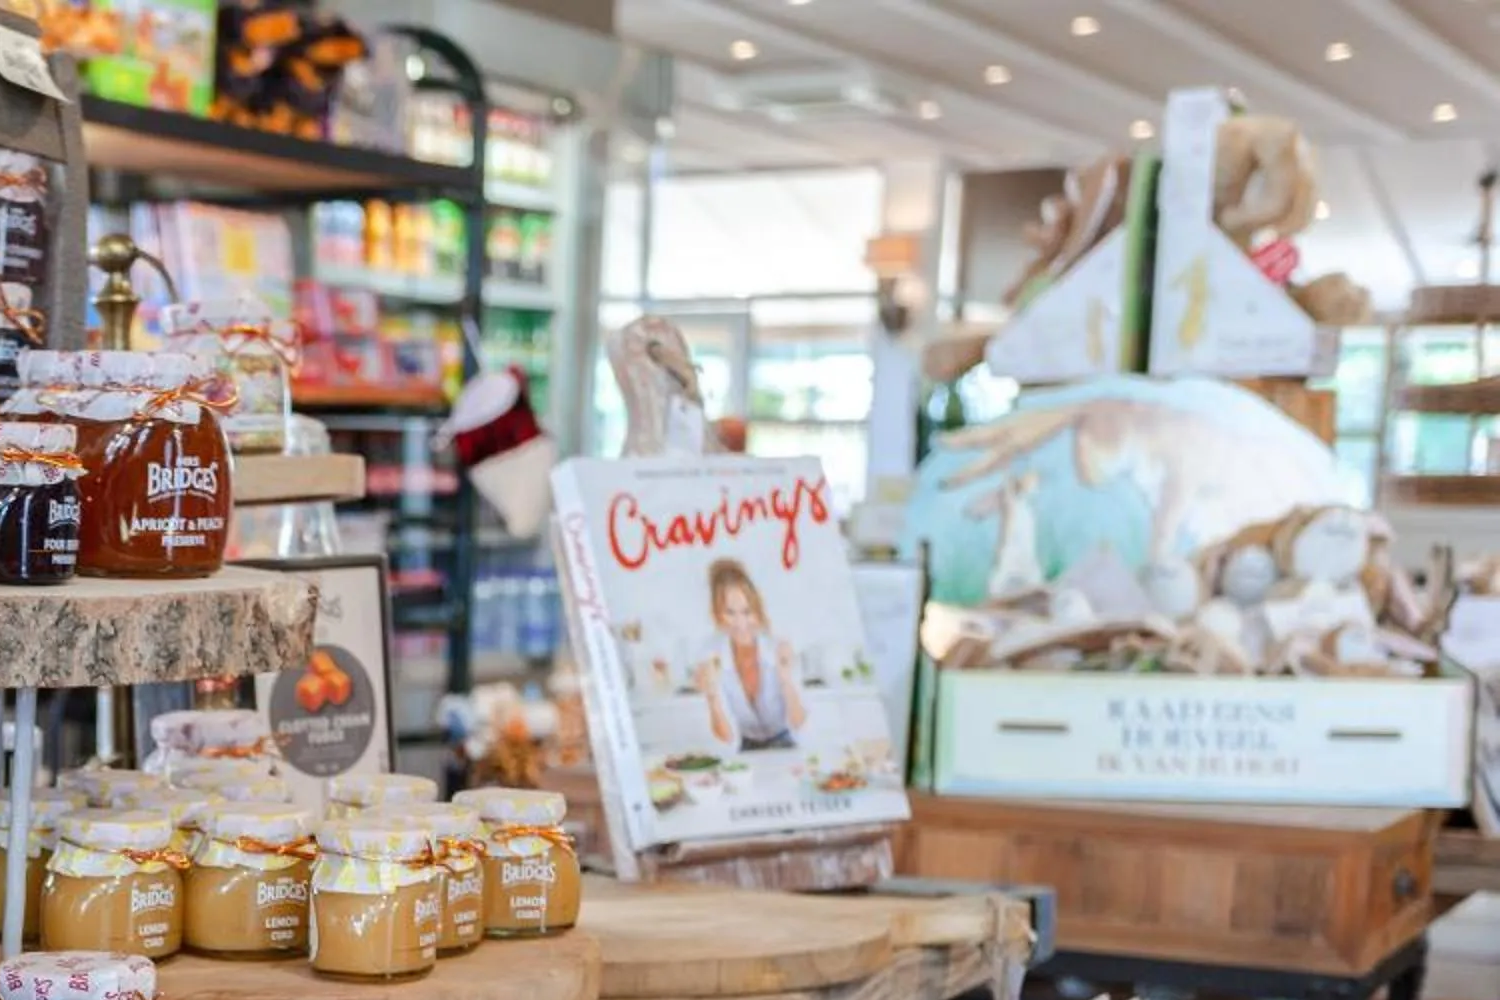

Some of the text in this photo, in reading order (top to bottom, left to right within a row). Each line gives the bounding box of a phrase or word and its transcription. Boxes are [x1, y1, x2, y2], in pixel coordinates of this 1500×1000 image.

[147, 461, 219, 497] BRIDGES
[130, 516, 187, 531] APRICOT
[607, 475, 830, 572] Cravings
[502, 862, 557, 884] BRIDGES
[131, 884, 176, 913] BRIDGES
[257, 880, 309, 906] BRIDGES
